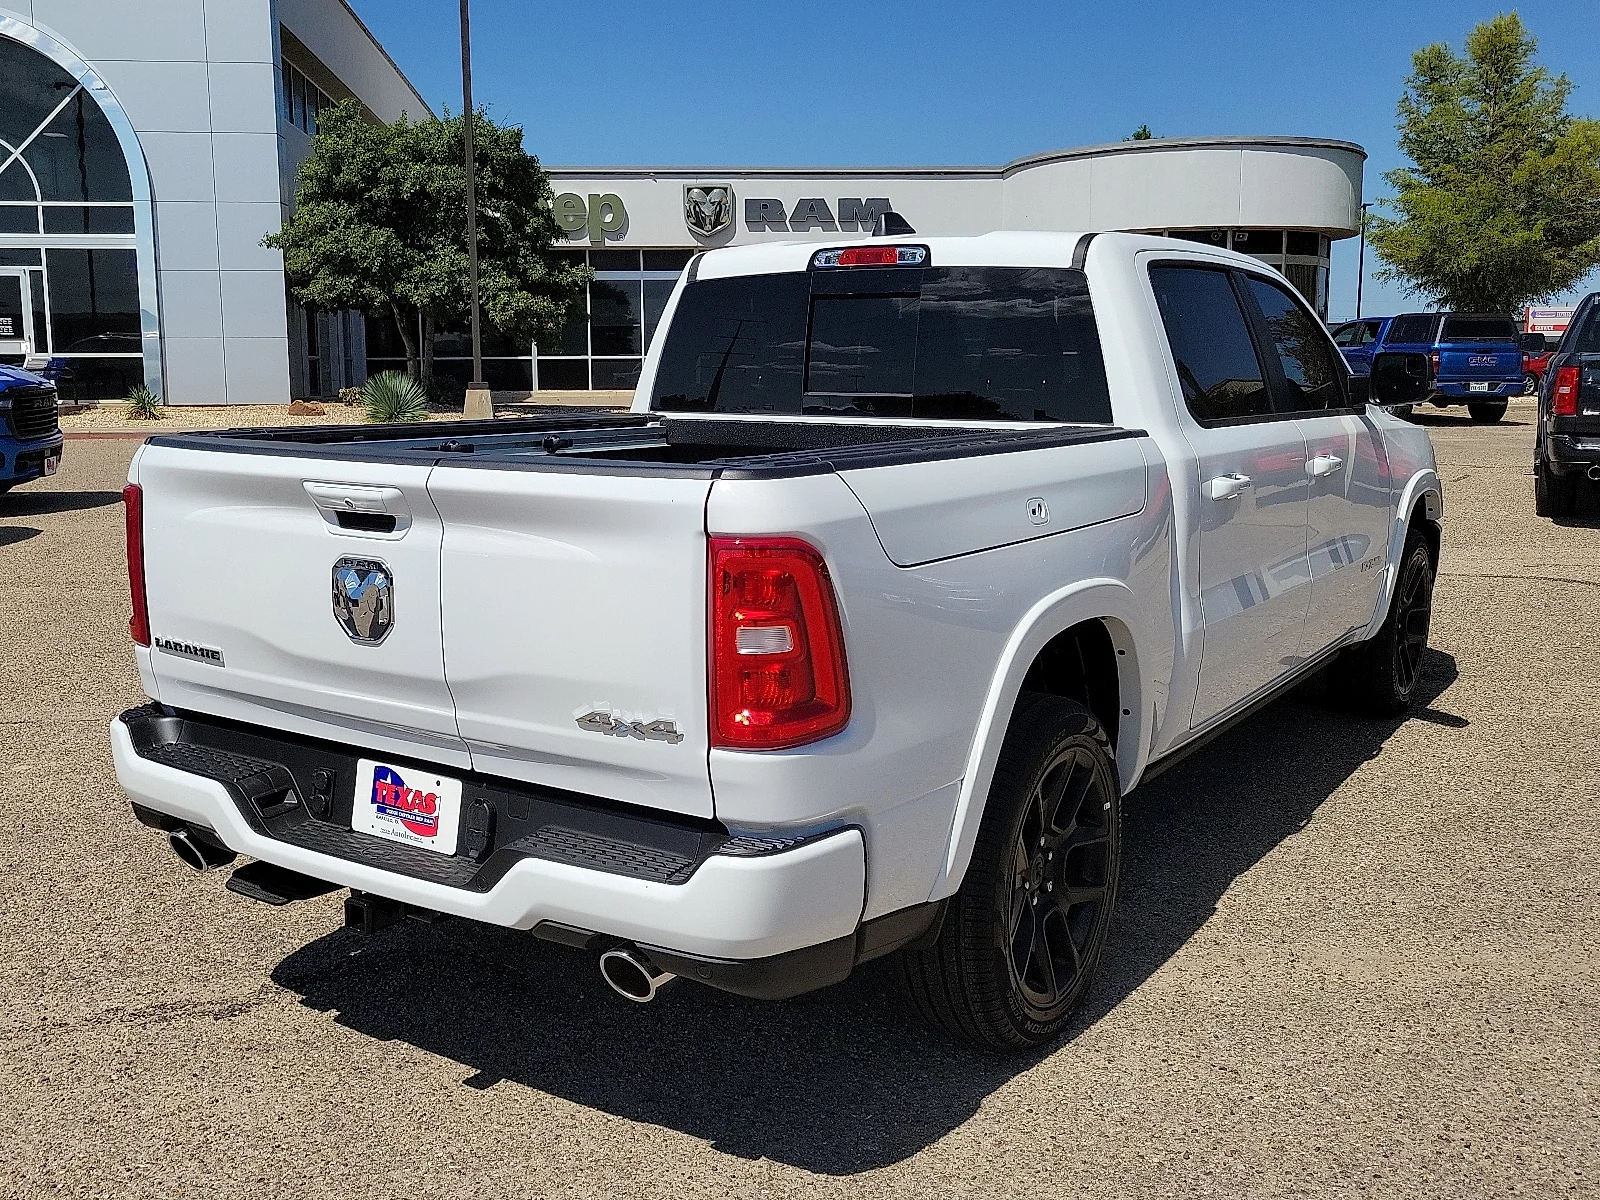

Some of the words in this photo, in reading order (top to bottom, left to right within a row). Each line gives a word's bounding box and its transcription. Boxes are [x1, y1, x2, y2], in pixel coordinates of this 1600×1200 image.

[744, 197, 891, 228] RAM
[1468, 355, 1497, 364] GMC
[154, 636, 223, 664] LARAMIE
[375, 780, 438, 816] TEXAS
